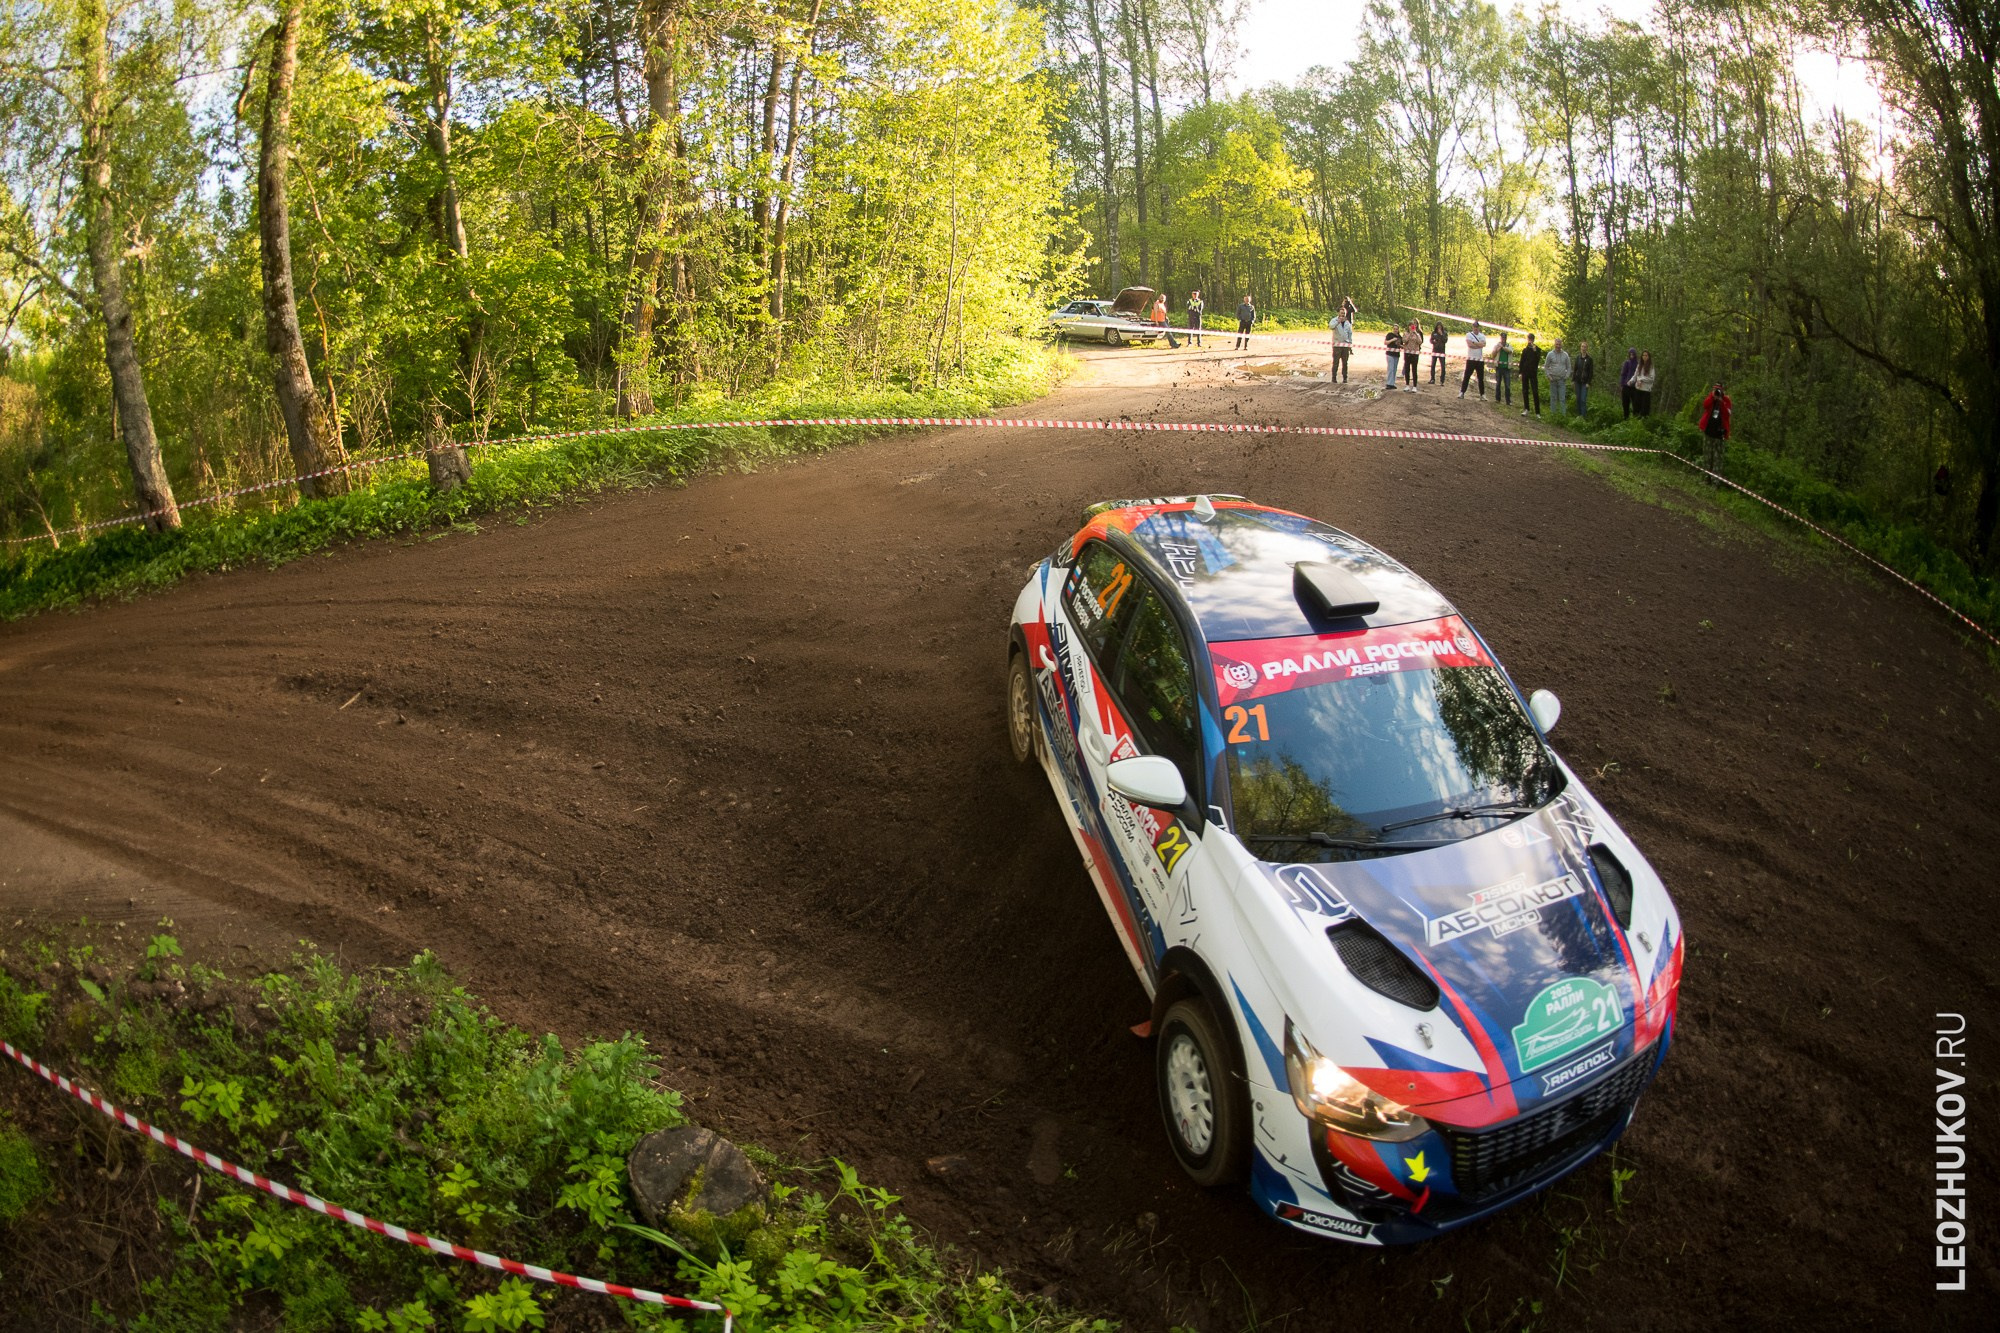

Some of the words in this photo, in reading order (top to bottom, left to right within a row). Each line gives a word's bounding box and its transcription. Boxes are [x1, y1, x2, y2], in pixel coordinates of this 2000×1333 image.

[1097, 563, 1133, 618] 21
[1262, 647, 1360, 680] РАЛЛИ
[1364, 640, 1457, 662] РОССИИ
[1350, 660, 1400, 677] ASMG
[1224, 704, 1270, 744] 21
[1134, 806, 1161, 845] 2025
[1156, 826, 1190, 874] 21
[1439, 877, 1575, 940] АБСОЛЮТ
[1545, 989, 1585, 1016] РАЛЛИ
[1550, 983, 1573, 1000] 2025
[1592, 990, 1620, 1032] 21
[1551, 1050, 1609, 1087] RAVENOL
[1302, 1212, 1363, 1235] YOKOHAMA
